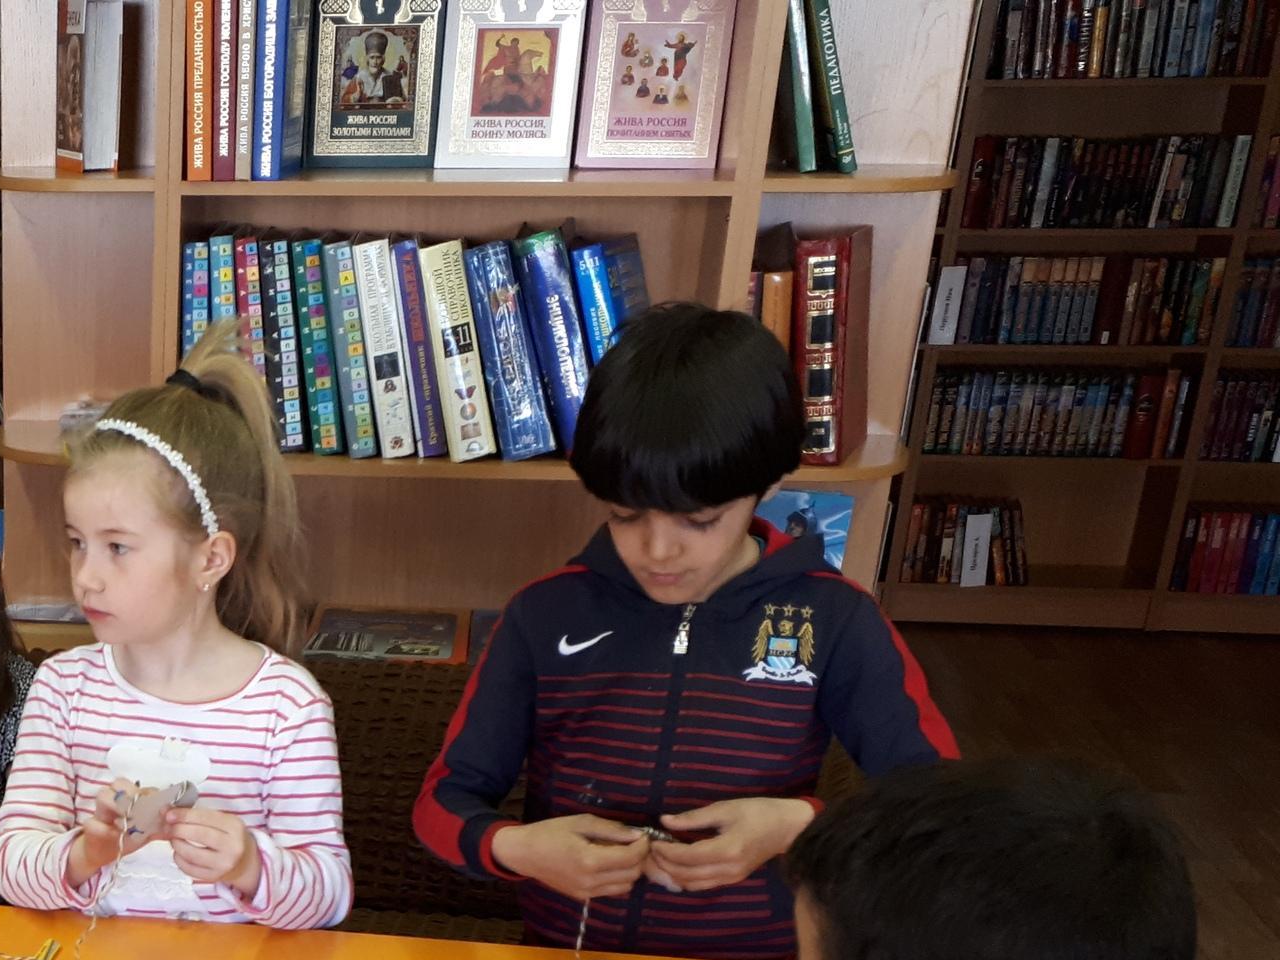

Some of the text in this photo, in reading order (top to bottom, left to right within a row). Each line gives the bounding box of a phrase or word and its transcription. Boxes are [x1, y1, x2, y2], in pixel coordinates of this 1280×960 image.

[220, 42, 231, 83] ГОСПОДУ
[241, 43, 250, 79] ВЕРОЮ
[193, 1, 204, 169] ЖИВА РОССИЯ ПРЕДАННОСТЬЮ
[220, 84, 230, 125] РОССИЯ
[240, 82, 249, 122] РОССИЯ
[262, 100, 273, 146] РОССИЯ
[332, 127, 411, 137] ЗОЛОТЫМИ КУПОЛАМИ
[347, 115, 397, 125] ЖИВА РОССИЯ
[473, 119, 506, 129] ЖИВА
[506, 130, 546, 139] МОЛЯСЬ
[614, 117, 687, 126] ЖИВА РОССИЯ
[219, 126, 229, 156] ЖИВА
[239, 126, 248, 154] ЖИВА
[261, 147, 271, 177] ЖИВА
[441, 249, 459, 321] СПРАВОЧНИК
[451, 249, 468, 317] ШКОЛЬНИКА
